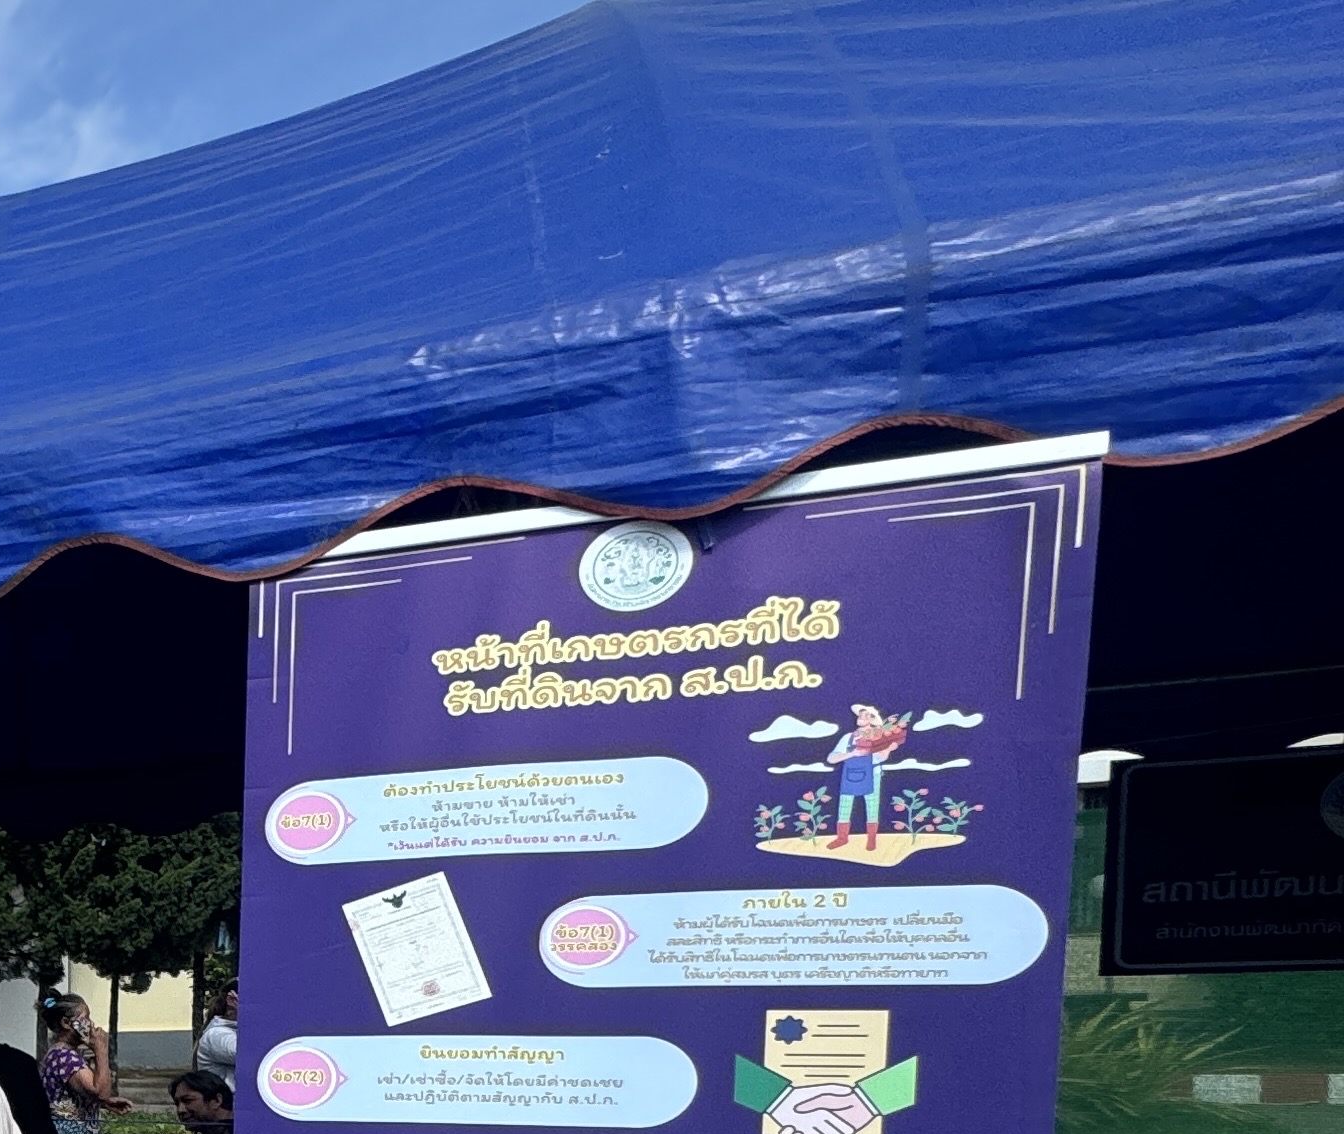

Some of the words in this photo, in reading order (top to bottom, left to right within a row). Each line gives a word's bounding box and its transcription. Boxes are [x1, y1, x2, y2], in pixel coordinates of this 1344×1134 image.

[432, 596, 840, 675] หน้าที่เกษตรกรที่ได้
[444, 667, 672, 717] รับที่ดินจาก
[680, 656, 823, 698] ส.ป.ก.
[383, 772, 624, 799] ต้องทำประโยชน์ด้วยตนเอง
[432, 797, 493, 813] ห้ามขาย
[498, 792, 575, 810] ห้ามให้เช่า
[281, 811, 332, 830] ข้อ7(1)
[378, 804, 637, 834] หรือให้ผู้อื่นใช้ประโยชน์ในที่ดินนั้น
[553, 835, 576, 846] จาก
[741, 891, 807, 911] ภายใน
[813, 895, 826, 910] 2
[831, 891, 849, 910] ปี
[555, 923, 614, 941] ข้อ7(1)
[550, 940, 617, 953] วรรคสอง
[420, 1043, 565, 1064] ยินยอมทำสัญญา
[272, 1069, 325, 1086] ข้อ7(2)
[384, 1089, 563, 1107] และปฏิบัติตามสัญญากับ
[568, 1092, 619, 1106] ส.ป.ก.
